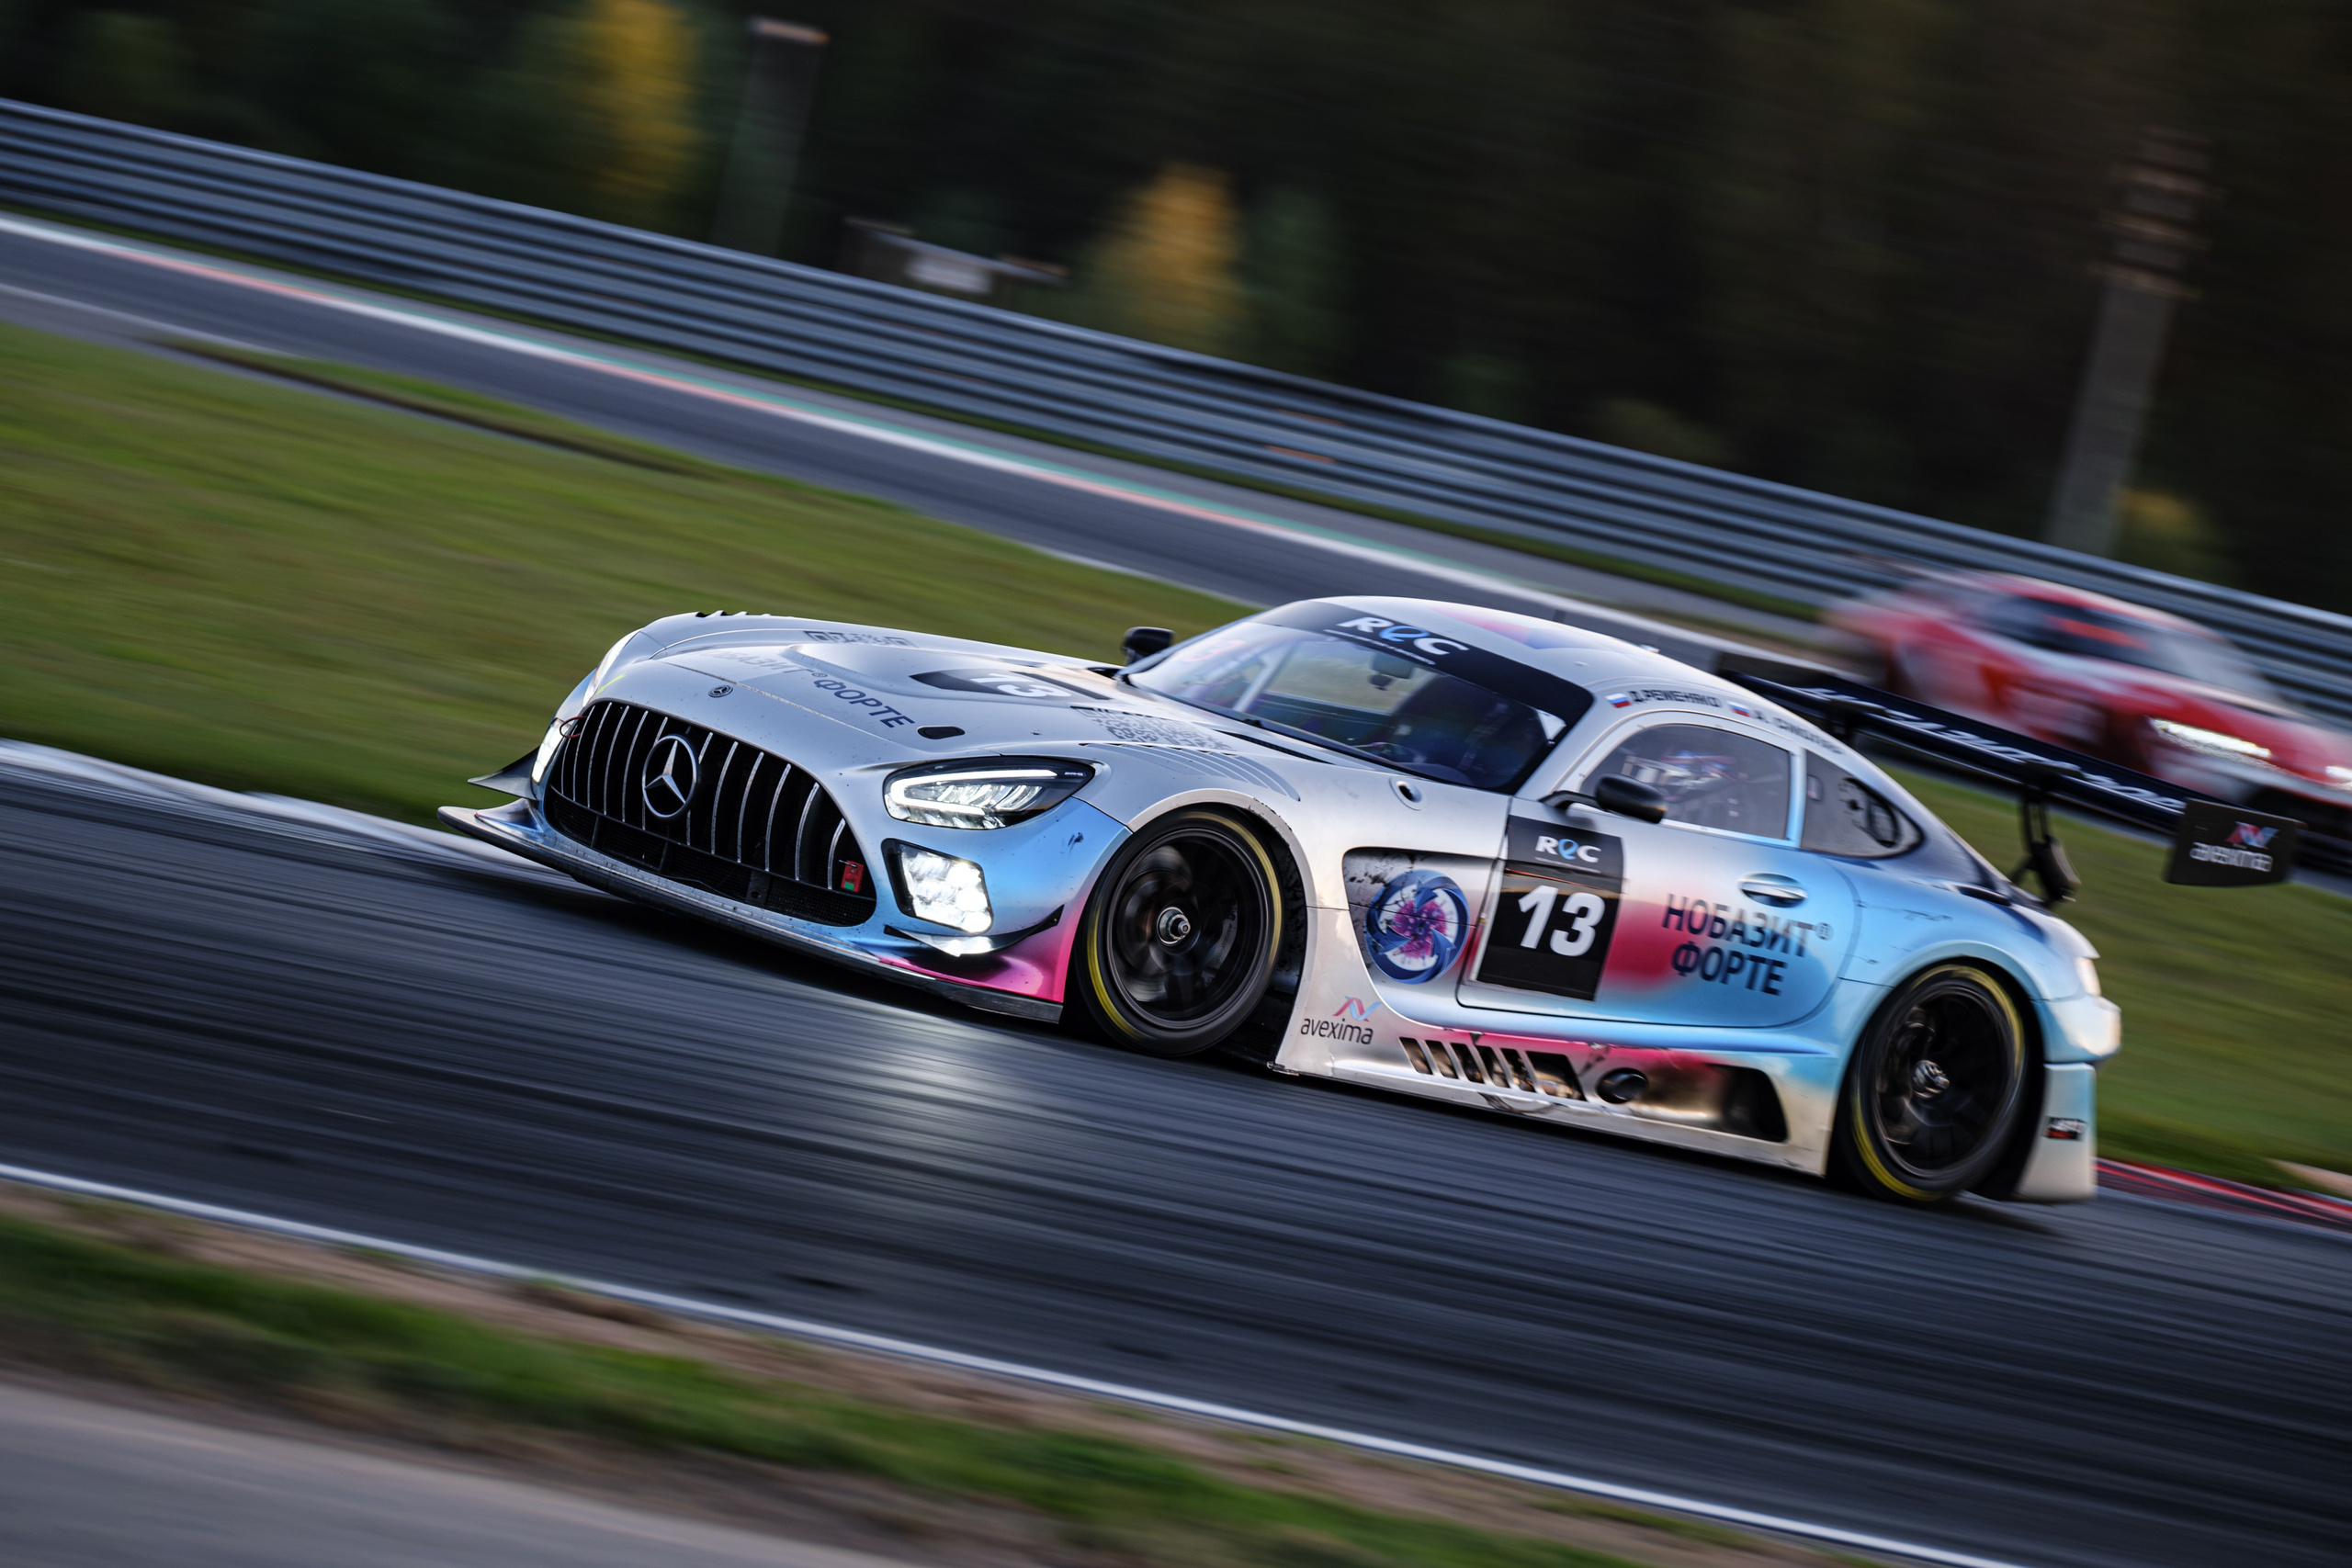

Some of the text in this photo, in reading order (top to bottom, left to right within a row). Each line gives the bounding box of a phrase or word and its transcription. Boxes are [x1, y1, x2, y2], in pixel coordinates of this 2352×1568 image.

[813, 679, 915, 728] ФОРТЕ
[970, 672, 1072, 697] 13
[1518, 885, 1606, 956] 13
[1671, 941, 1788, 996] ФОРТЕ
[1300, 1018, 1374, 1044] avexima
